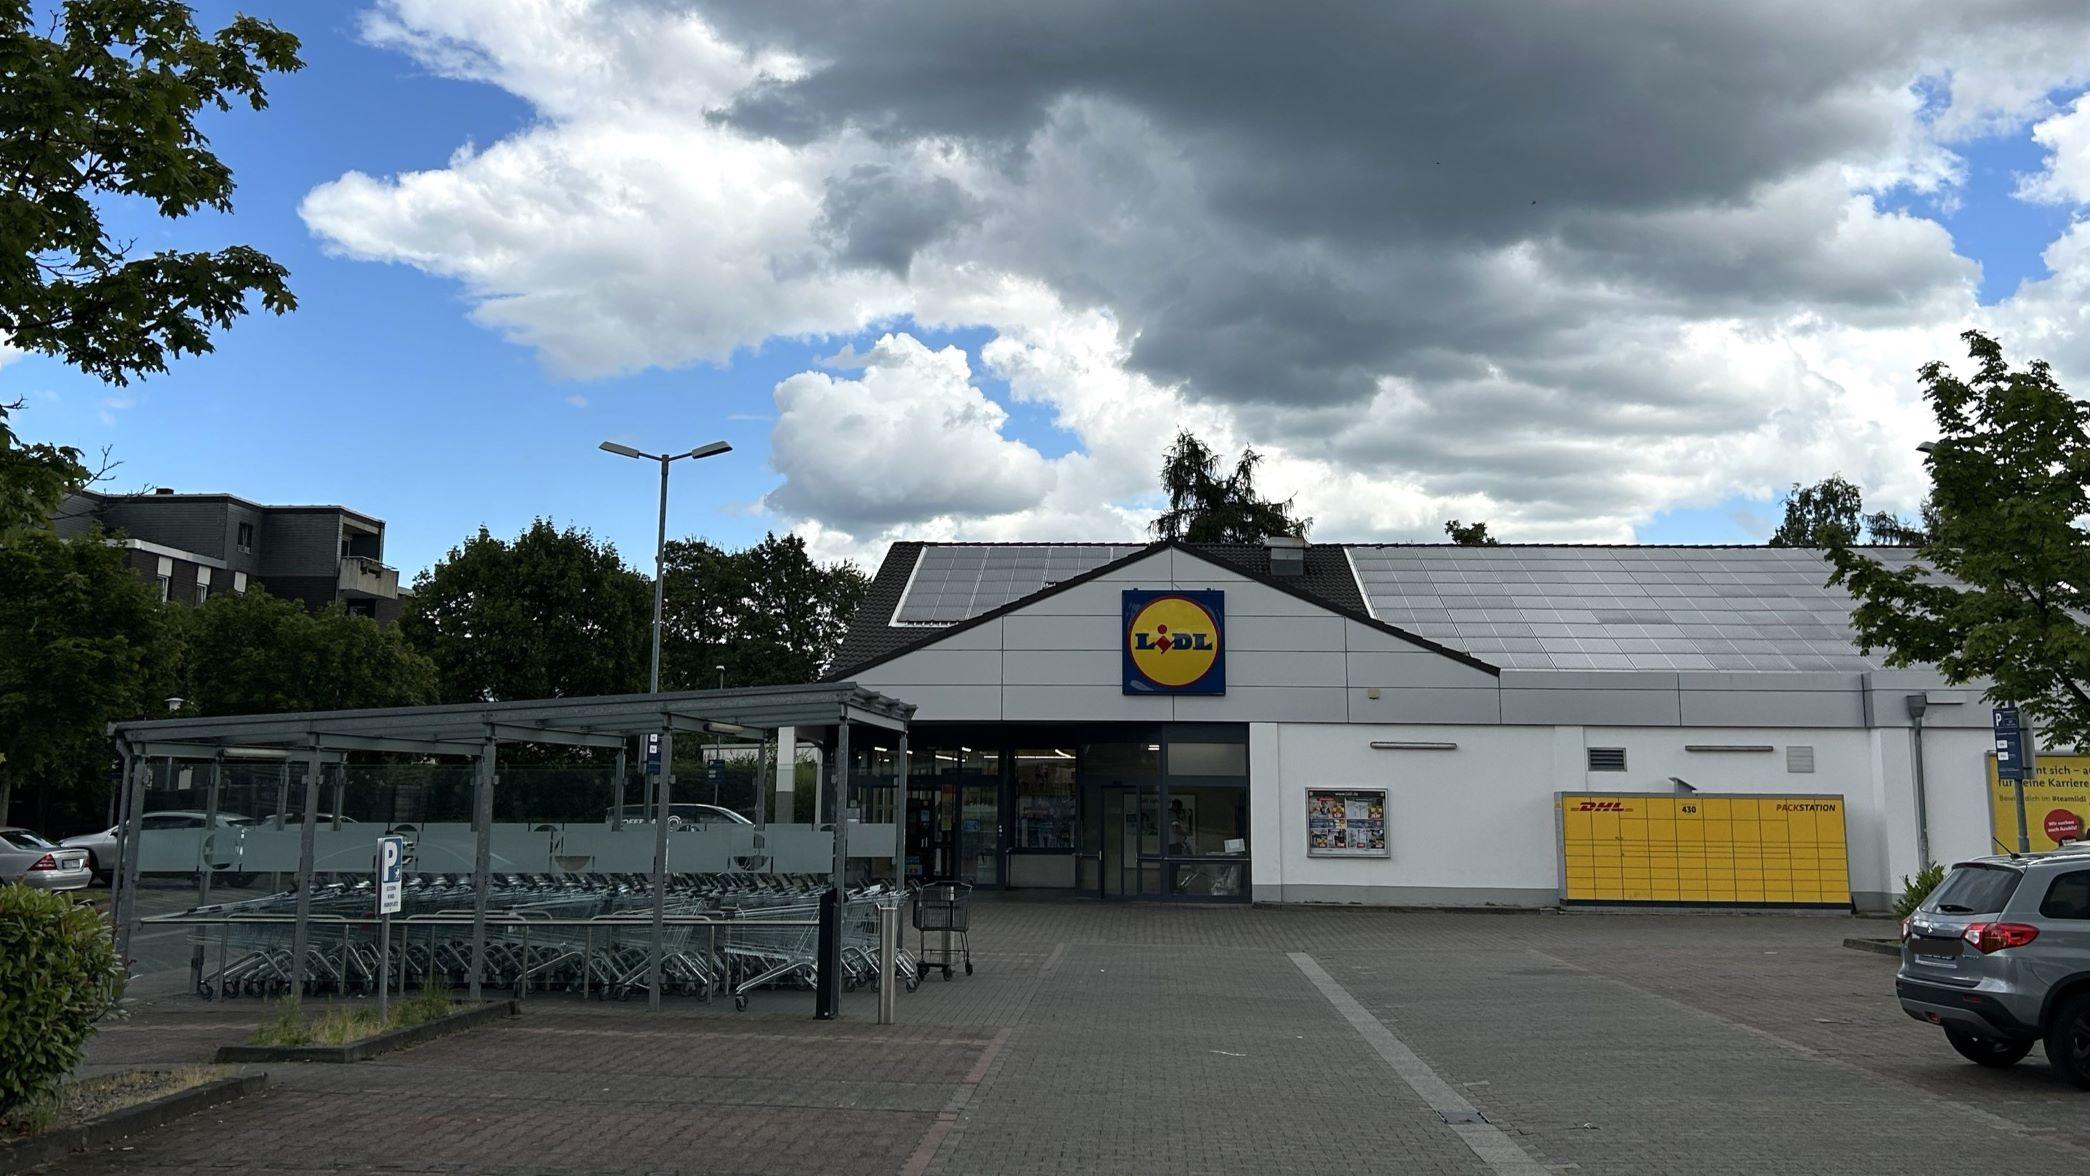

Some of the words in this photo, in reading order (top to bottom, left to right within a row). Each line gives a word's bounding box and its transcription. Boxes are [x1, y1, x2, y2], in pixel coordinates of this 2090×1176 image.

[1996, 713, 2002, 726] P
[2049, 766, 2071, 775] sich
[2048, 778, 2090, 787] Karriere
[1579, 801, 1625, 812] DHL
[1682, 806, 1697, 814] 430
[1776, 803, 1836, 812] PACKSTATION
[384, 841, 398, 881] P
